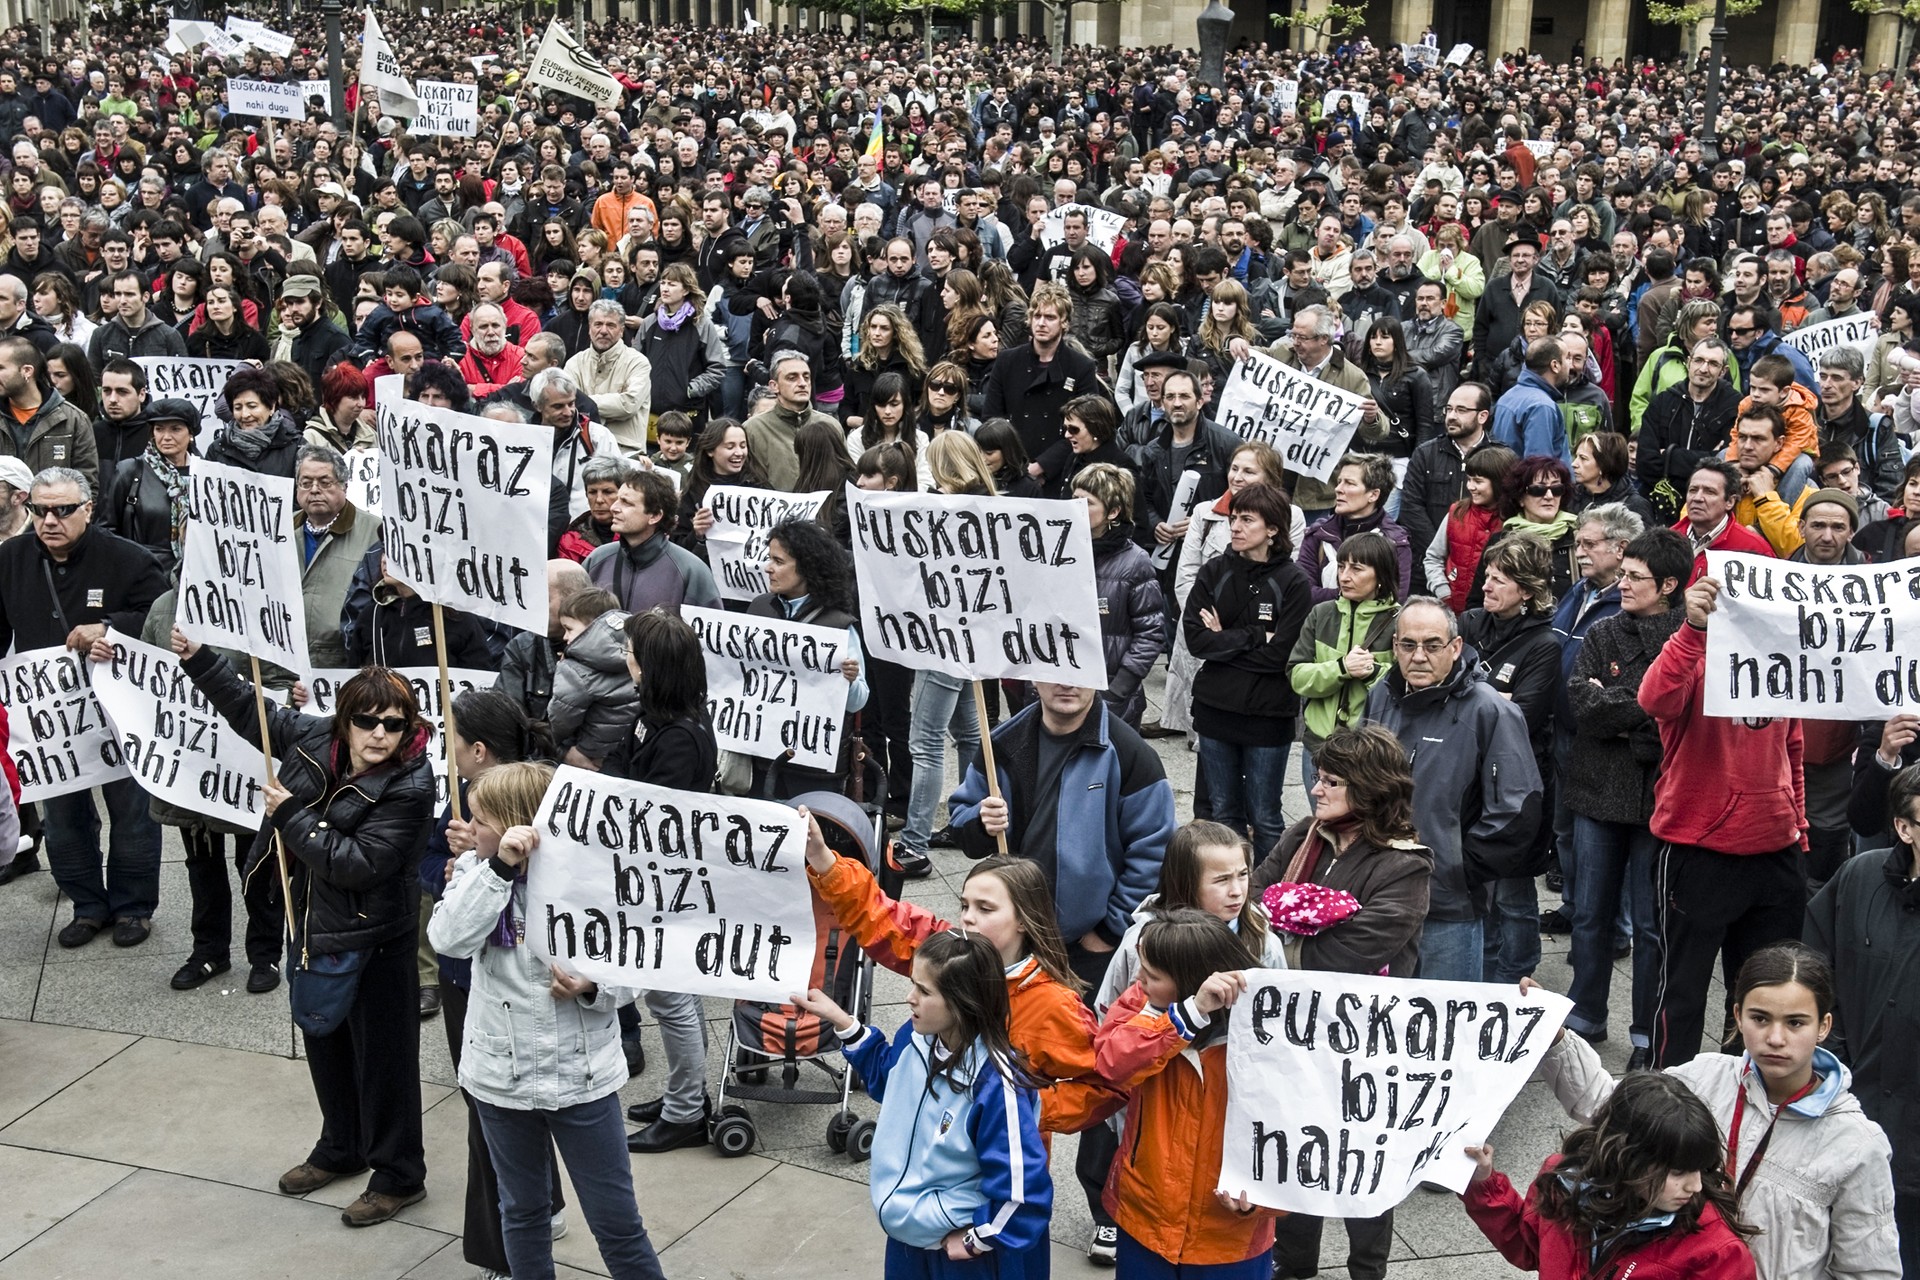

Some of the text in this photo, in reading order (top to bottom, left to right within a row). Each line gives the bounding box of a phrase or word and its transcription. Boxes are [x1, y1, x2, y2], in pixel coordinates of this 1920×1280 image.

[230, 80, 299, 97] EUSKARAZ bizi
[416, 85, 474, 103] uskaraz
[539, 66, 609, 102] EUSKARAZ
[541, 58, 613, 97] EUSKAL HERRIAN
[245, 101, 289, 114] nahi dugu
[427, 101, 453, 116] bizi
[447, 118, 471, 132] dut
[1785, 320, 1871, 354] skaraz
[1240, 356, 1357, 425] euskaraz
[1262, 396, 1312, 437] bizi
[376, 402, 535, 497] uskaraz
[1224, 409, 1331, 470] nahi dut
[188, 474, 287, 544] uskaraz
[395, 468, 468, 540] bizi
[214, 529, 265, 590] bizi
[855, 502, 1076, 567] euskaraz
[457, 546, 529, 610] dut
[721, 558, 769, 594] nahi
[920, 561, 1013, 613] bizi
[185, 577, 295, 654] nahi dut
[874, 606, 1081, 669] nahi dut
[1798, 604, 1894, 653] bizi
[740, 661, 798, 707] bizi
[1730, 652, 1843, 704] nahi
[27, 691, 107, 743] bizi
[155, 700, 219, 759] bizi
[781, 711, 836, 756] dut
[15, 741, 80, 787] ahi
[124, 732, 180, 788] ahi
[200, 763, 262, 814] dut
[548, 781, 789, 872] euskaraz
[614, 853, 716, 914] bizi
[546, 904, 791, 981] nahi dut
[1252, 985, 1545, 1063] euskaraz
[1341, 1058, 1452, 1131] bizi
[1252, 1121, 1387, 1195] nahi
